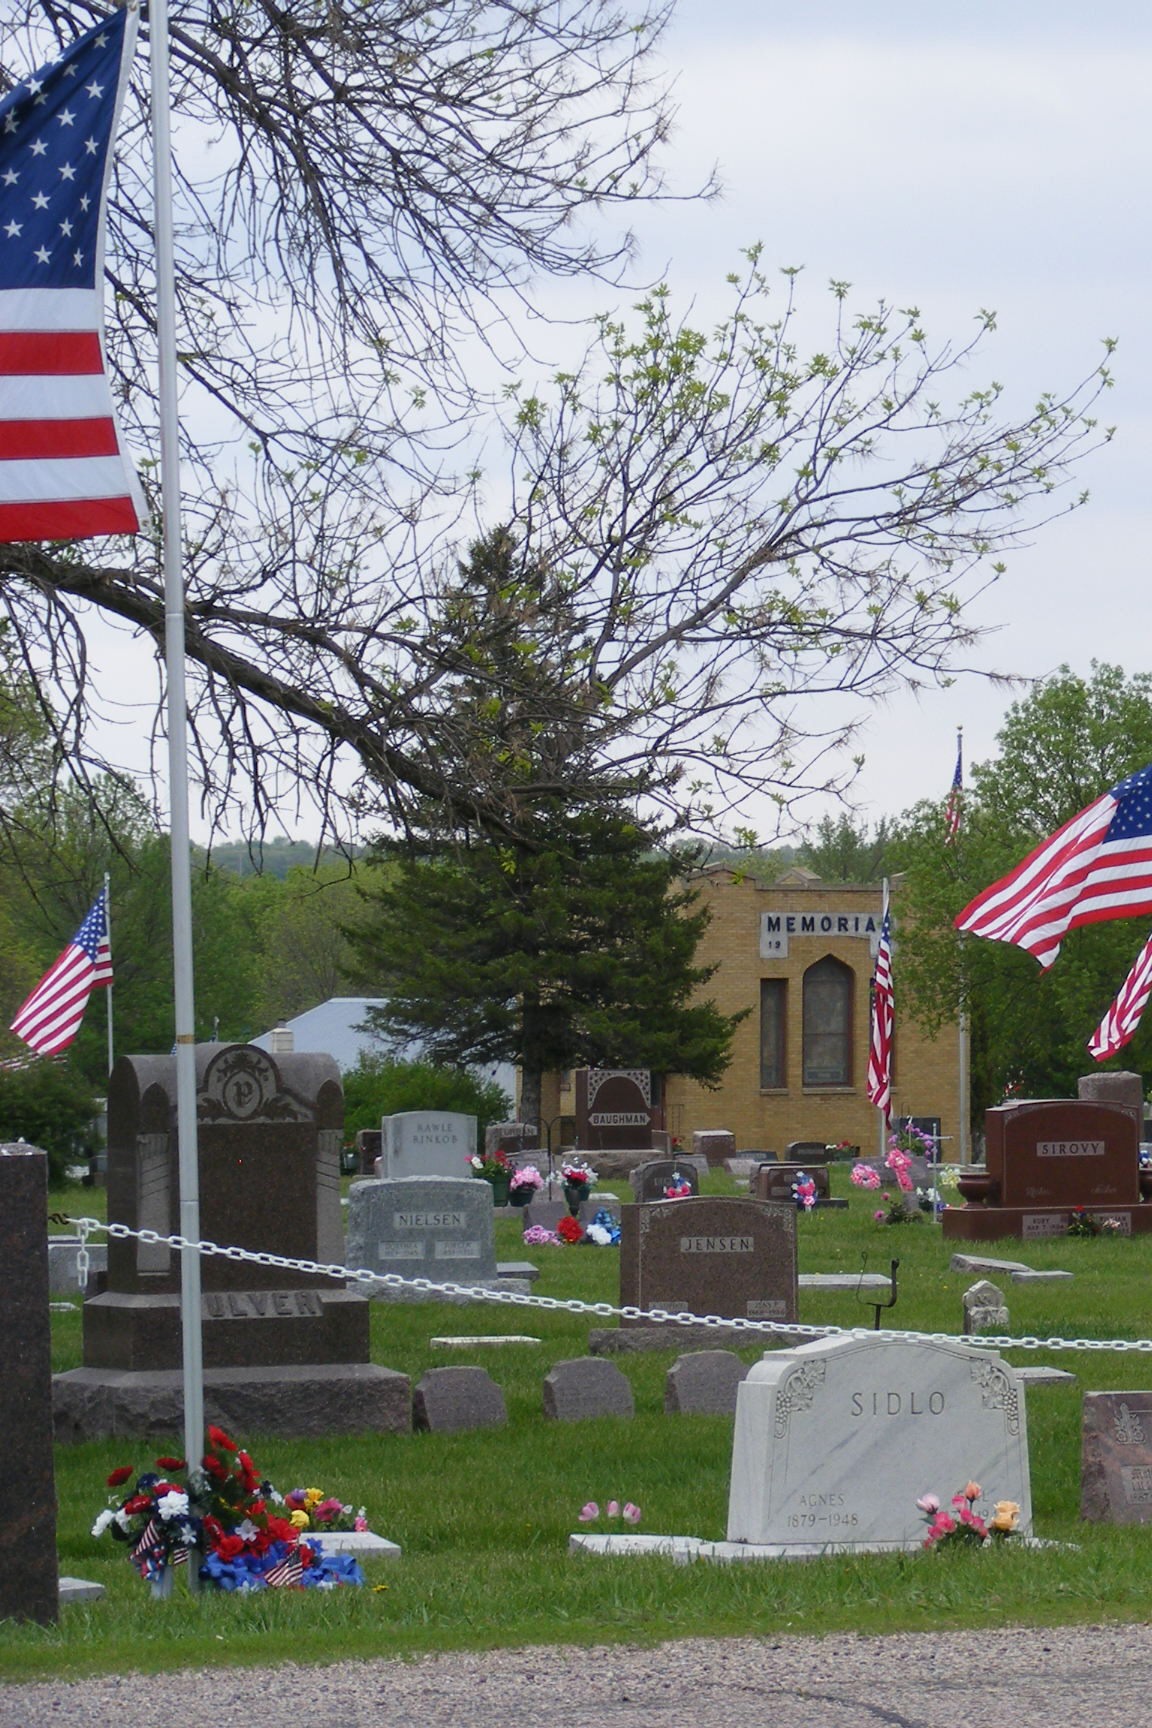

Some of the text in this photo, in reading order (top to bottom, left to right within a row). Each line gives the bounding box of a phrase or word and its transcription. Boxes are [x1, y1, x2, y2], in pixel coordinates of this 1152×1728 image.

[767, 916, 876, 933] MEMORIA
[767, 940, 782, 949] 19
[592, 1114, 646, 1124] BAUGHMAN
[413, 1135, 458, 1144] RINKOB
[1042, 1143, 1100, 1155] SIROVY
[399, 1214, 461, 1226] NIELSEN
[686, 1238, 750, 1251] JENSEN
[205, 1290, 322, 1317] ULVER
[851, 1391, 945, 1416] SIDLO
[800, 1492, 846, 1507] AGNES
